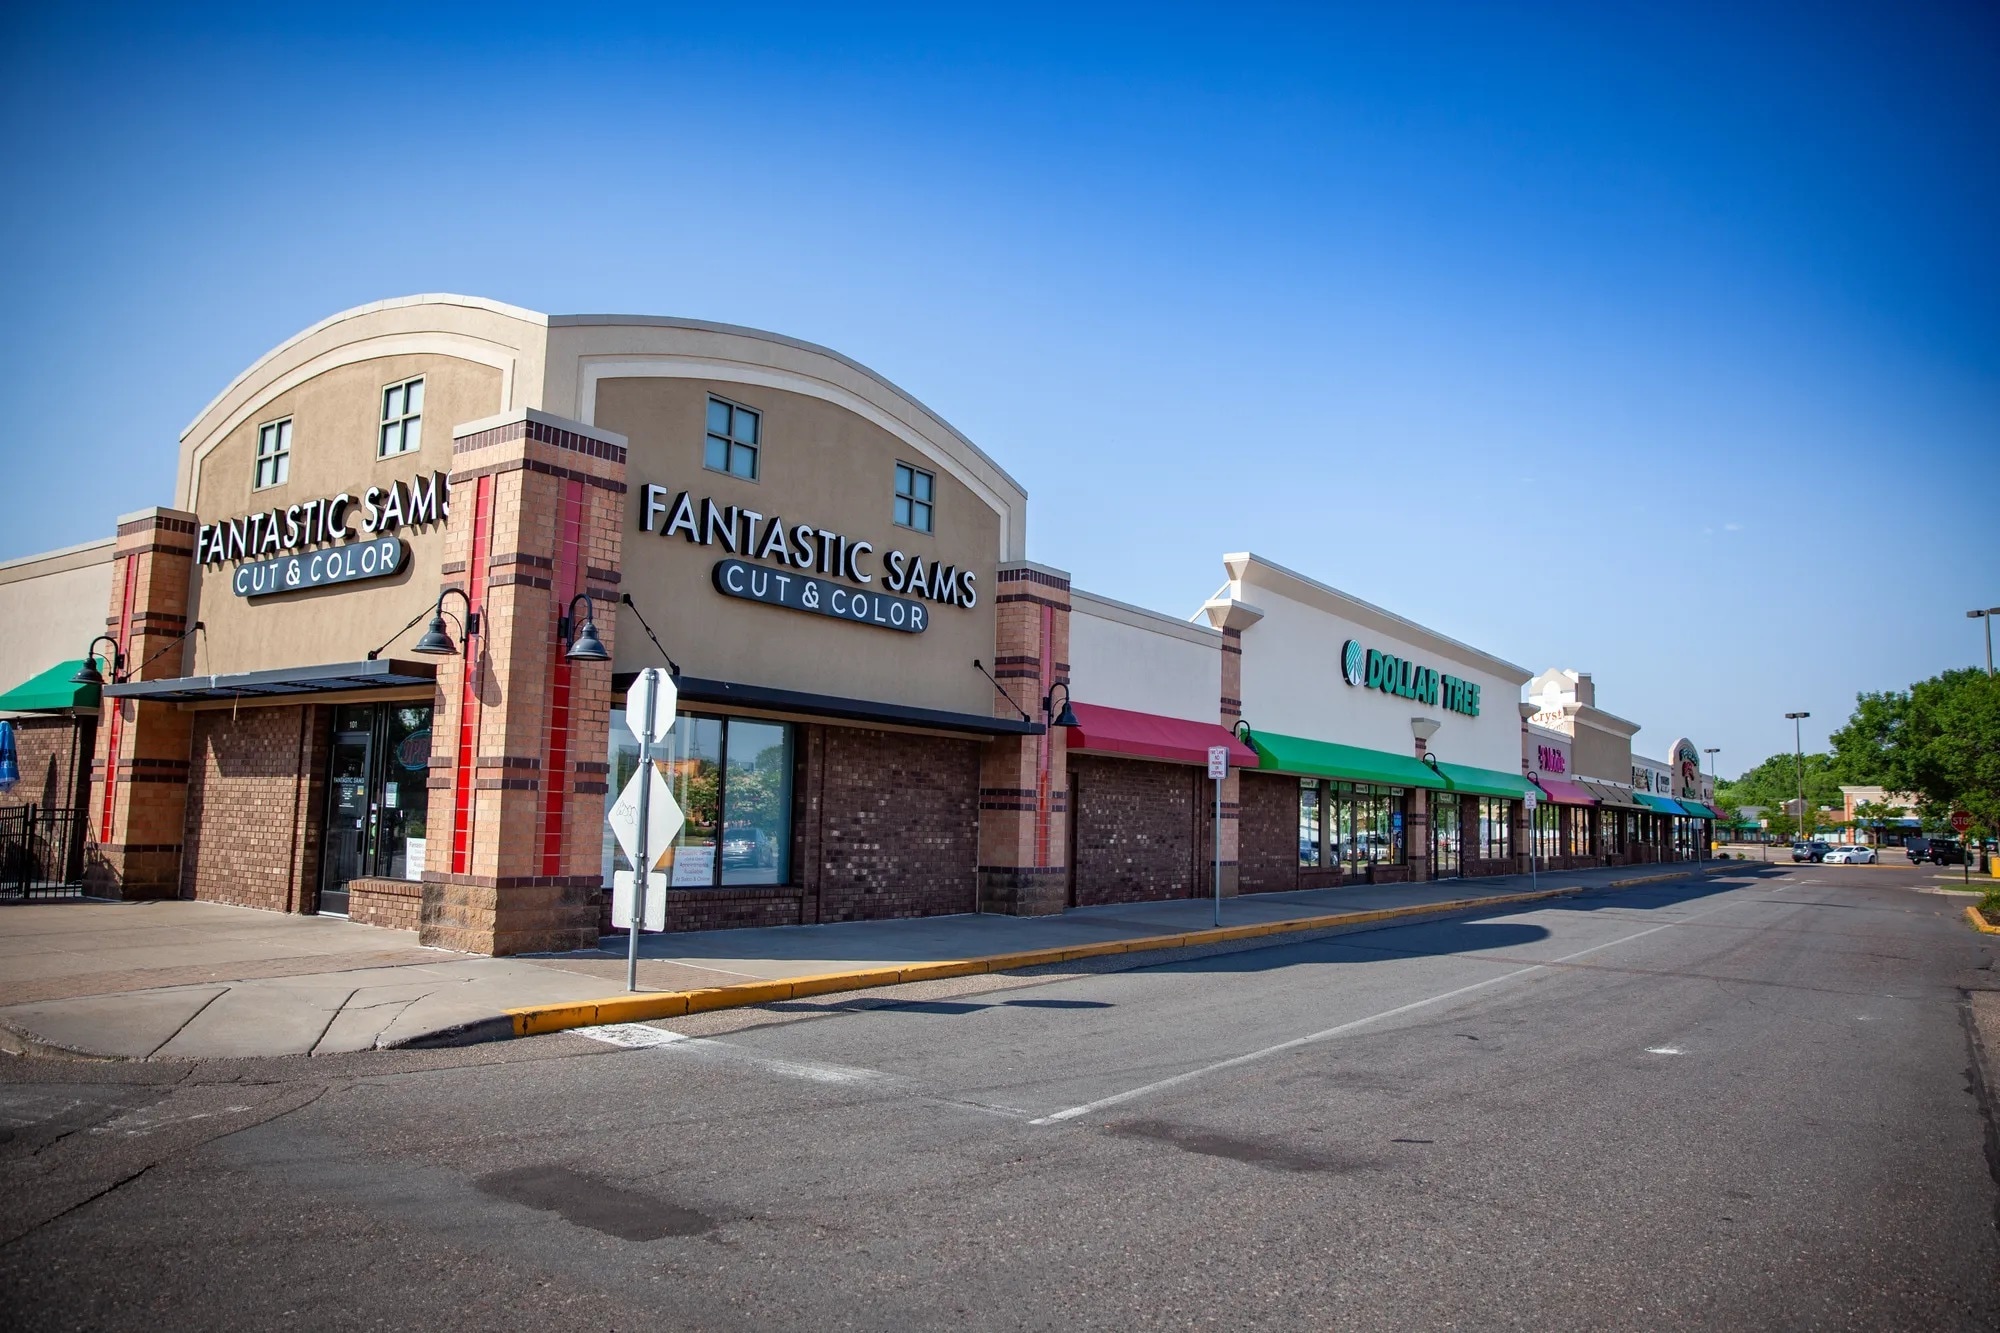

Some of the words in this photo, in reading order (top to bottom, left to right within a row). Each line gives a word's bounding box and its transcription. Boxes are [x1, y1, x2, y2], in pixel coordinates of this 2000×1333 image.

[196, 491, 350, 565] FANTASTIC
[641, 484, 873, 584] FANTASTIC
[883, 550, 977, 609] SAMS
[236, 563, 279, 593] CUT
[286, 558, 300, 586] &
[310, 542, 394, 582] COLOR
[726, 565, 791, 602] CUT
[802, 581, 819, 609] &
[831, 589, 923, 630] COLOR
[1364, 649, 1439, 706] DOLLAR
[1441, 674, 1481, 717] TREE
[350, 720, 358, 728] 101
[1531, 709, 1562, 724] Cryst
